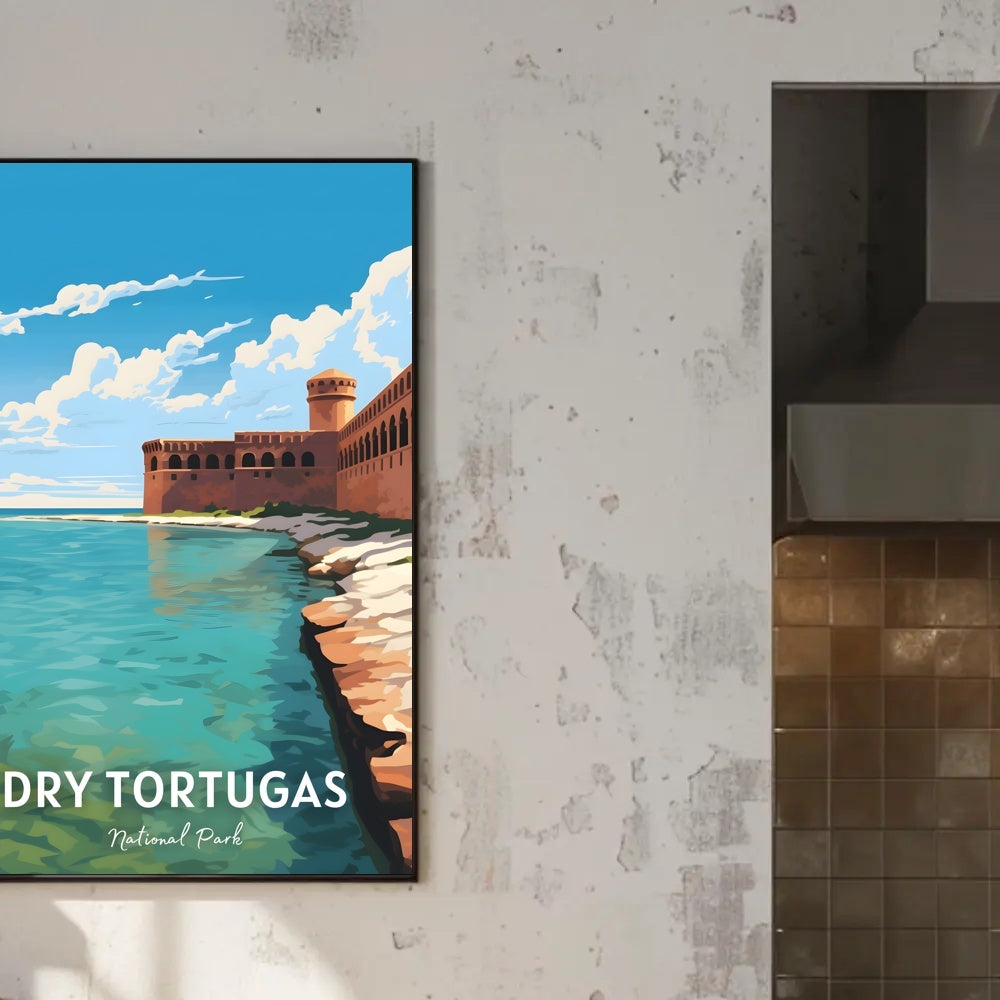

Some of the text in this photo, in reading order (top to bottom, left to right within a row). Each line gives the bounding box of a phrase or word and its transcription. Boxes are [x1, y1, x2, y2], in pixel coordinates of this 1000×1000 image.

[4, 770, 347, 808] DRY TORTUGAS
[108, 822, 244, 851] National Park
